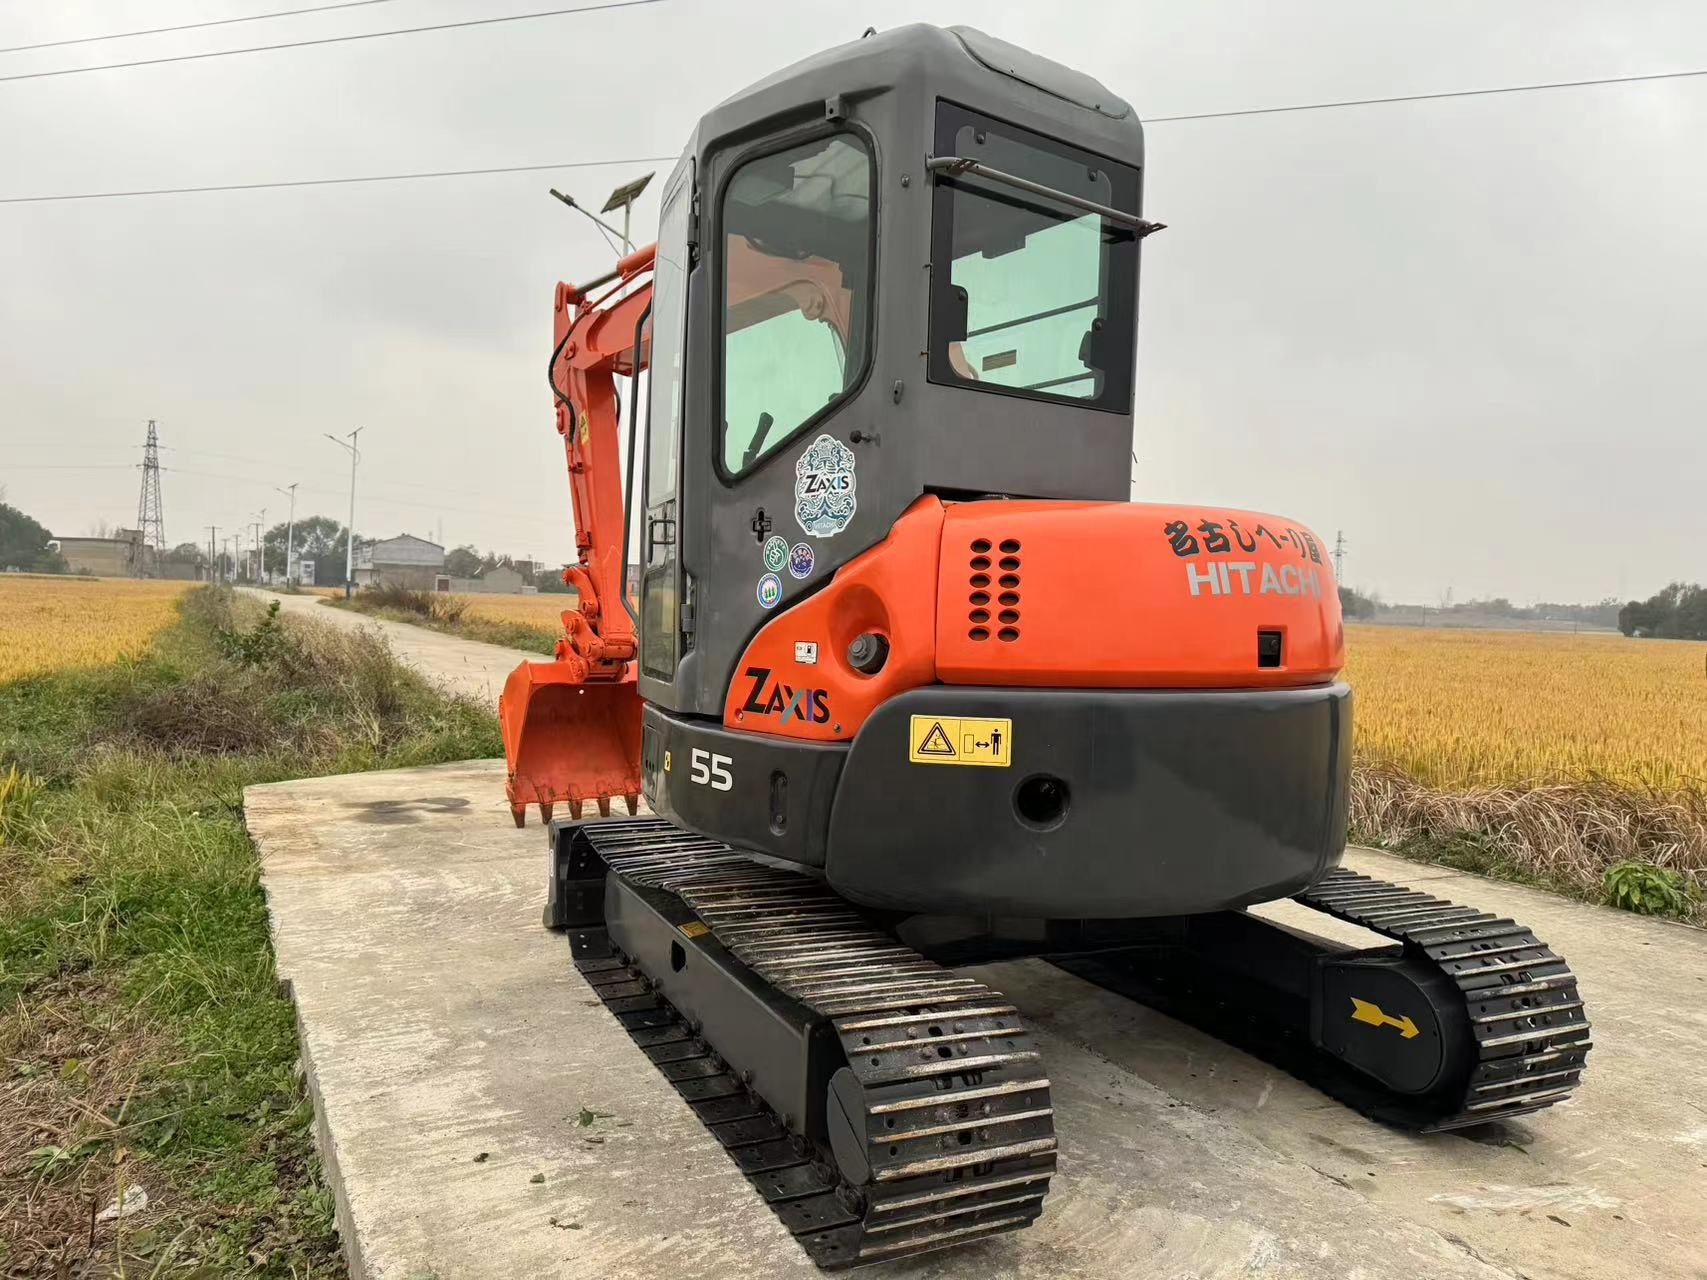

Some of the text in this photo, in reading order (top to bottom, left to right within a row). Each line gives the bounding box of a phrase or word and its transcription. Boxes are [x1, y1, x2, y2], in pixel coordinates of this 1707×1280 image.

[804, 473, 850, 494] ZAXIS
[1185, 562, 1322, 598] HITACHI
[742, 666, 830, 725] ZAXIS
[690, 747, 733, 791] 55
